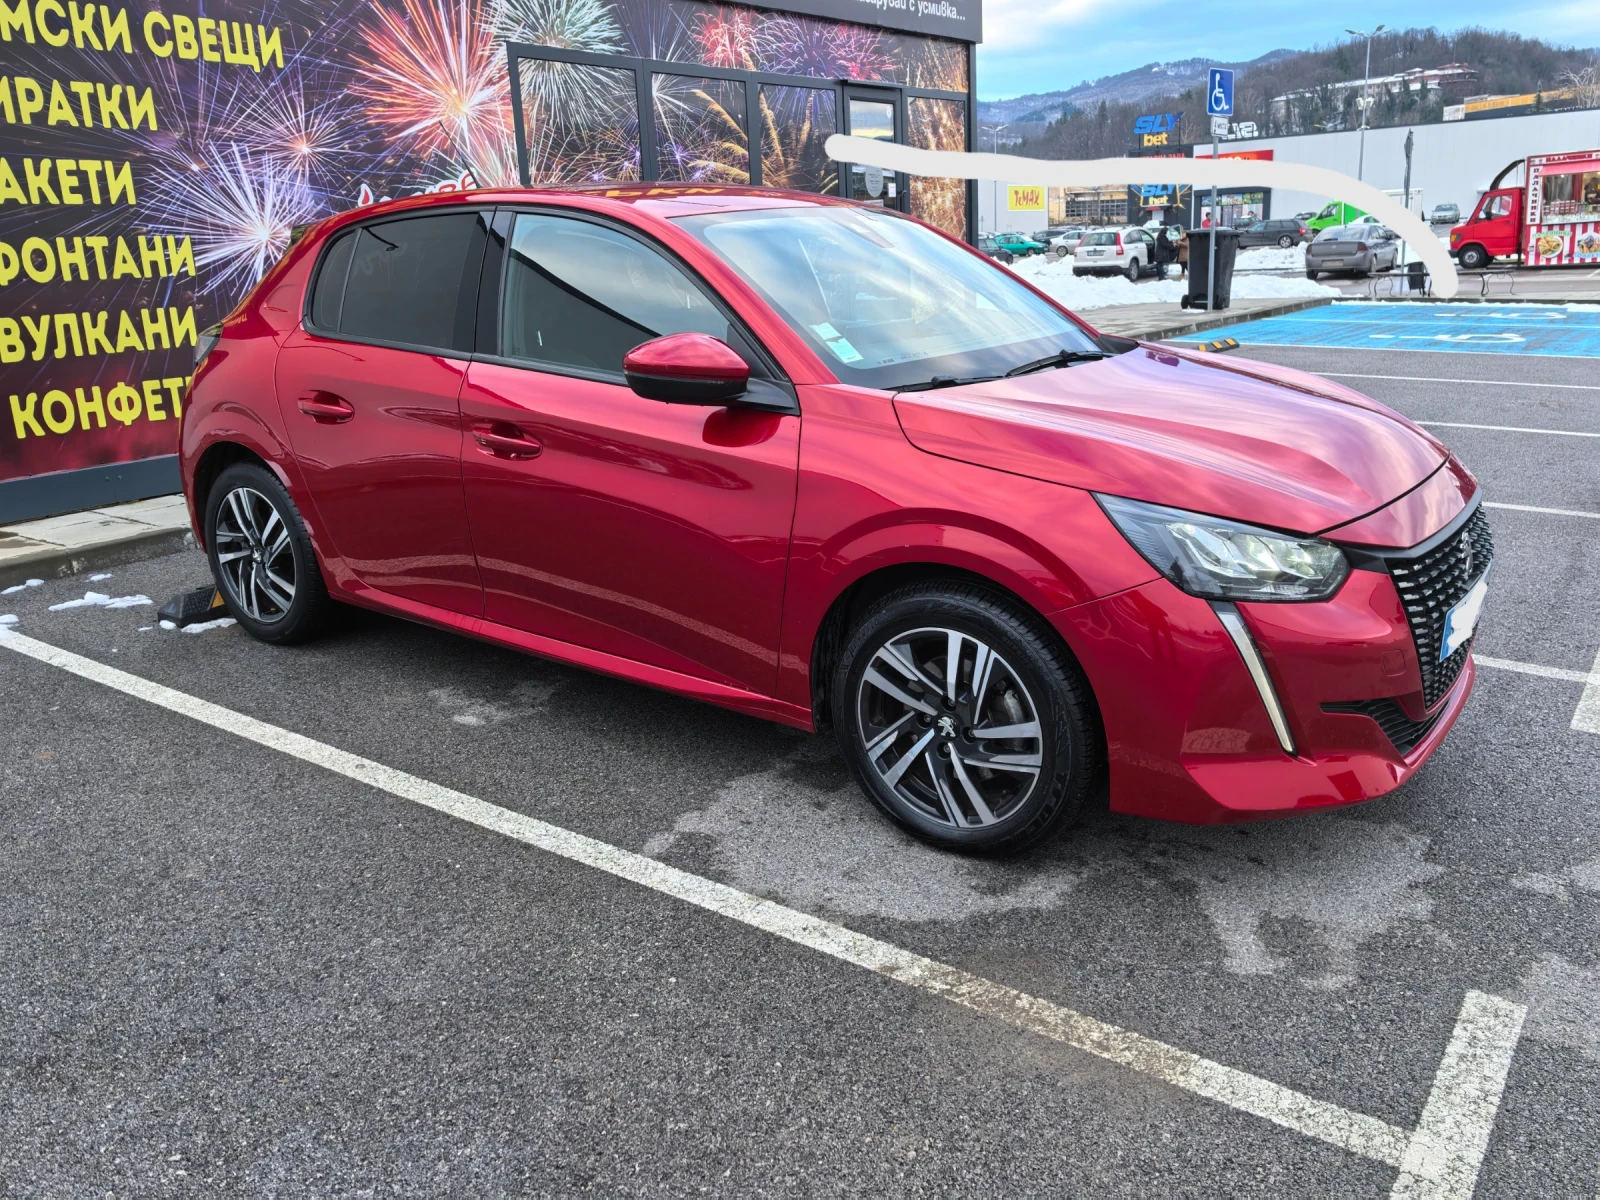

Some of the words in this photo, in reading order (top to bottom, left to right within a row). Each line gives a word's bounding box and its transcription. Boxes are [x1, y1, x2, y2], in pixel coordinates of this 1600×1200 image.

[143, 11, 285, 72] СВЕЩИ
[1133, 112, 1185, 134] SLY
[1143, 132, 1168, 146] bet
[0, 157, 137, 205] АКЕТИ
[1530, 168, 1540, 222] ПАЛАЧИНКИ
[0, 306, 198, 364] ВУЛКАНИ
[9, 376, 192, 439] КОНФЕТ
